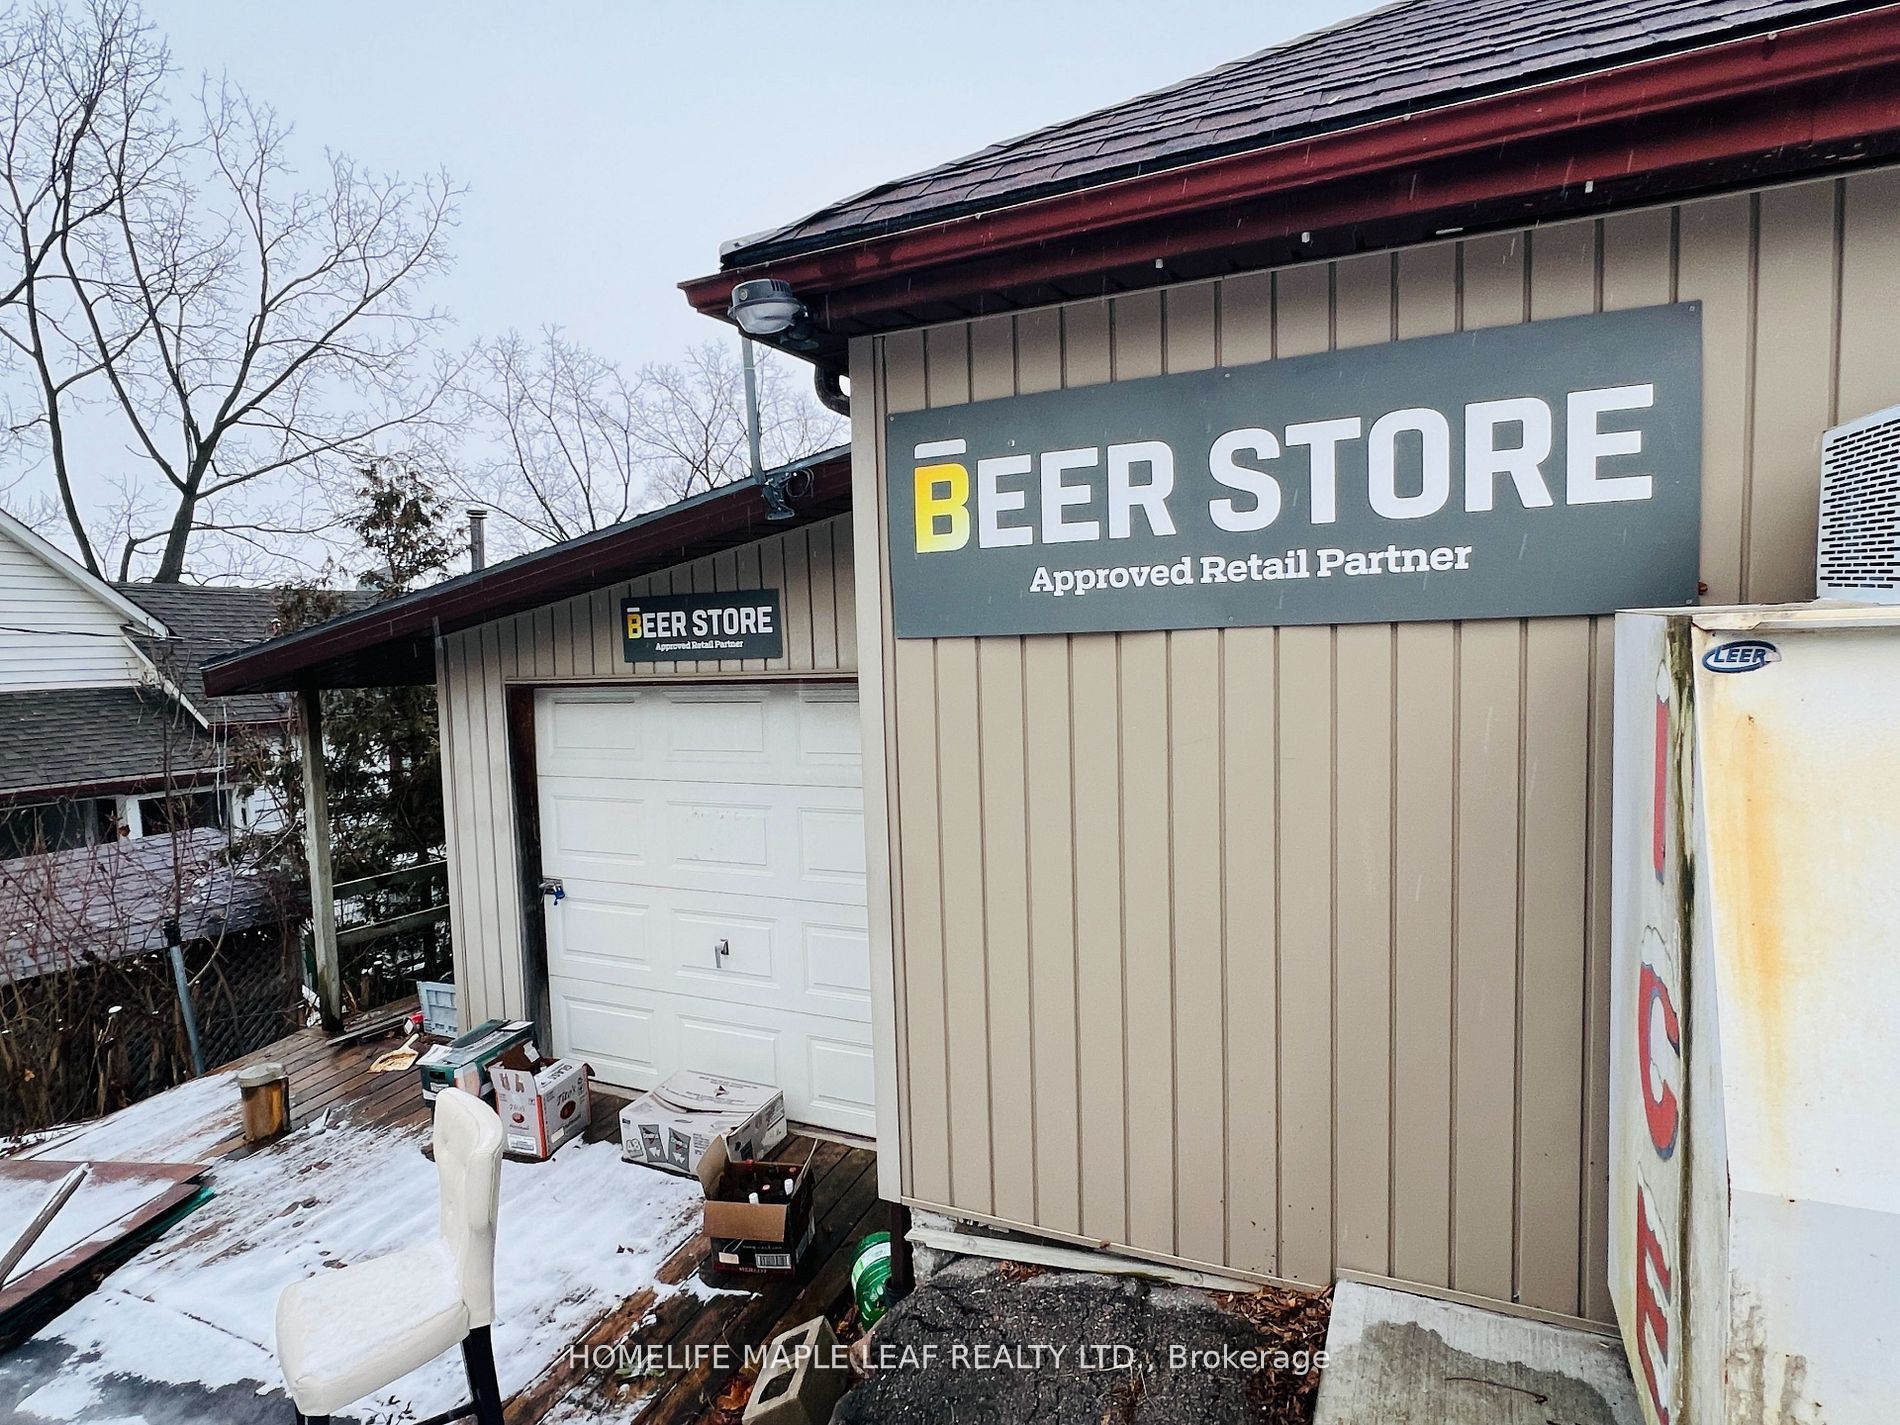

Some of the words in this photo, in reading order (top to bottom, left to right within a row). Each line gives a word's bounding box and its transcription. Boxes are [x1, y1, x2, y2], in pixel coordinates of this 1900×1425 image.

[914, 438, 1177, 555] BEER
[1207, 383, 1655, 534] STORE
[1029, 556, 1194, 597] Approved
[1199, 548, 1310, 584] Retail
[1316, 544, 1473, 578] Partner
[627, 607, 688, 639] BEER
[692, 606, 774, 637] STORE
[655, 641, 691, 652] Approved
[691, 640, 714, 649] Retail
[714, 640, 744, 649] Partner
[1713, 645, 1766, 663] LEER
[626, 1138, 641, 1151] 48
